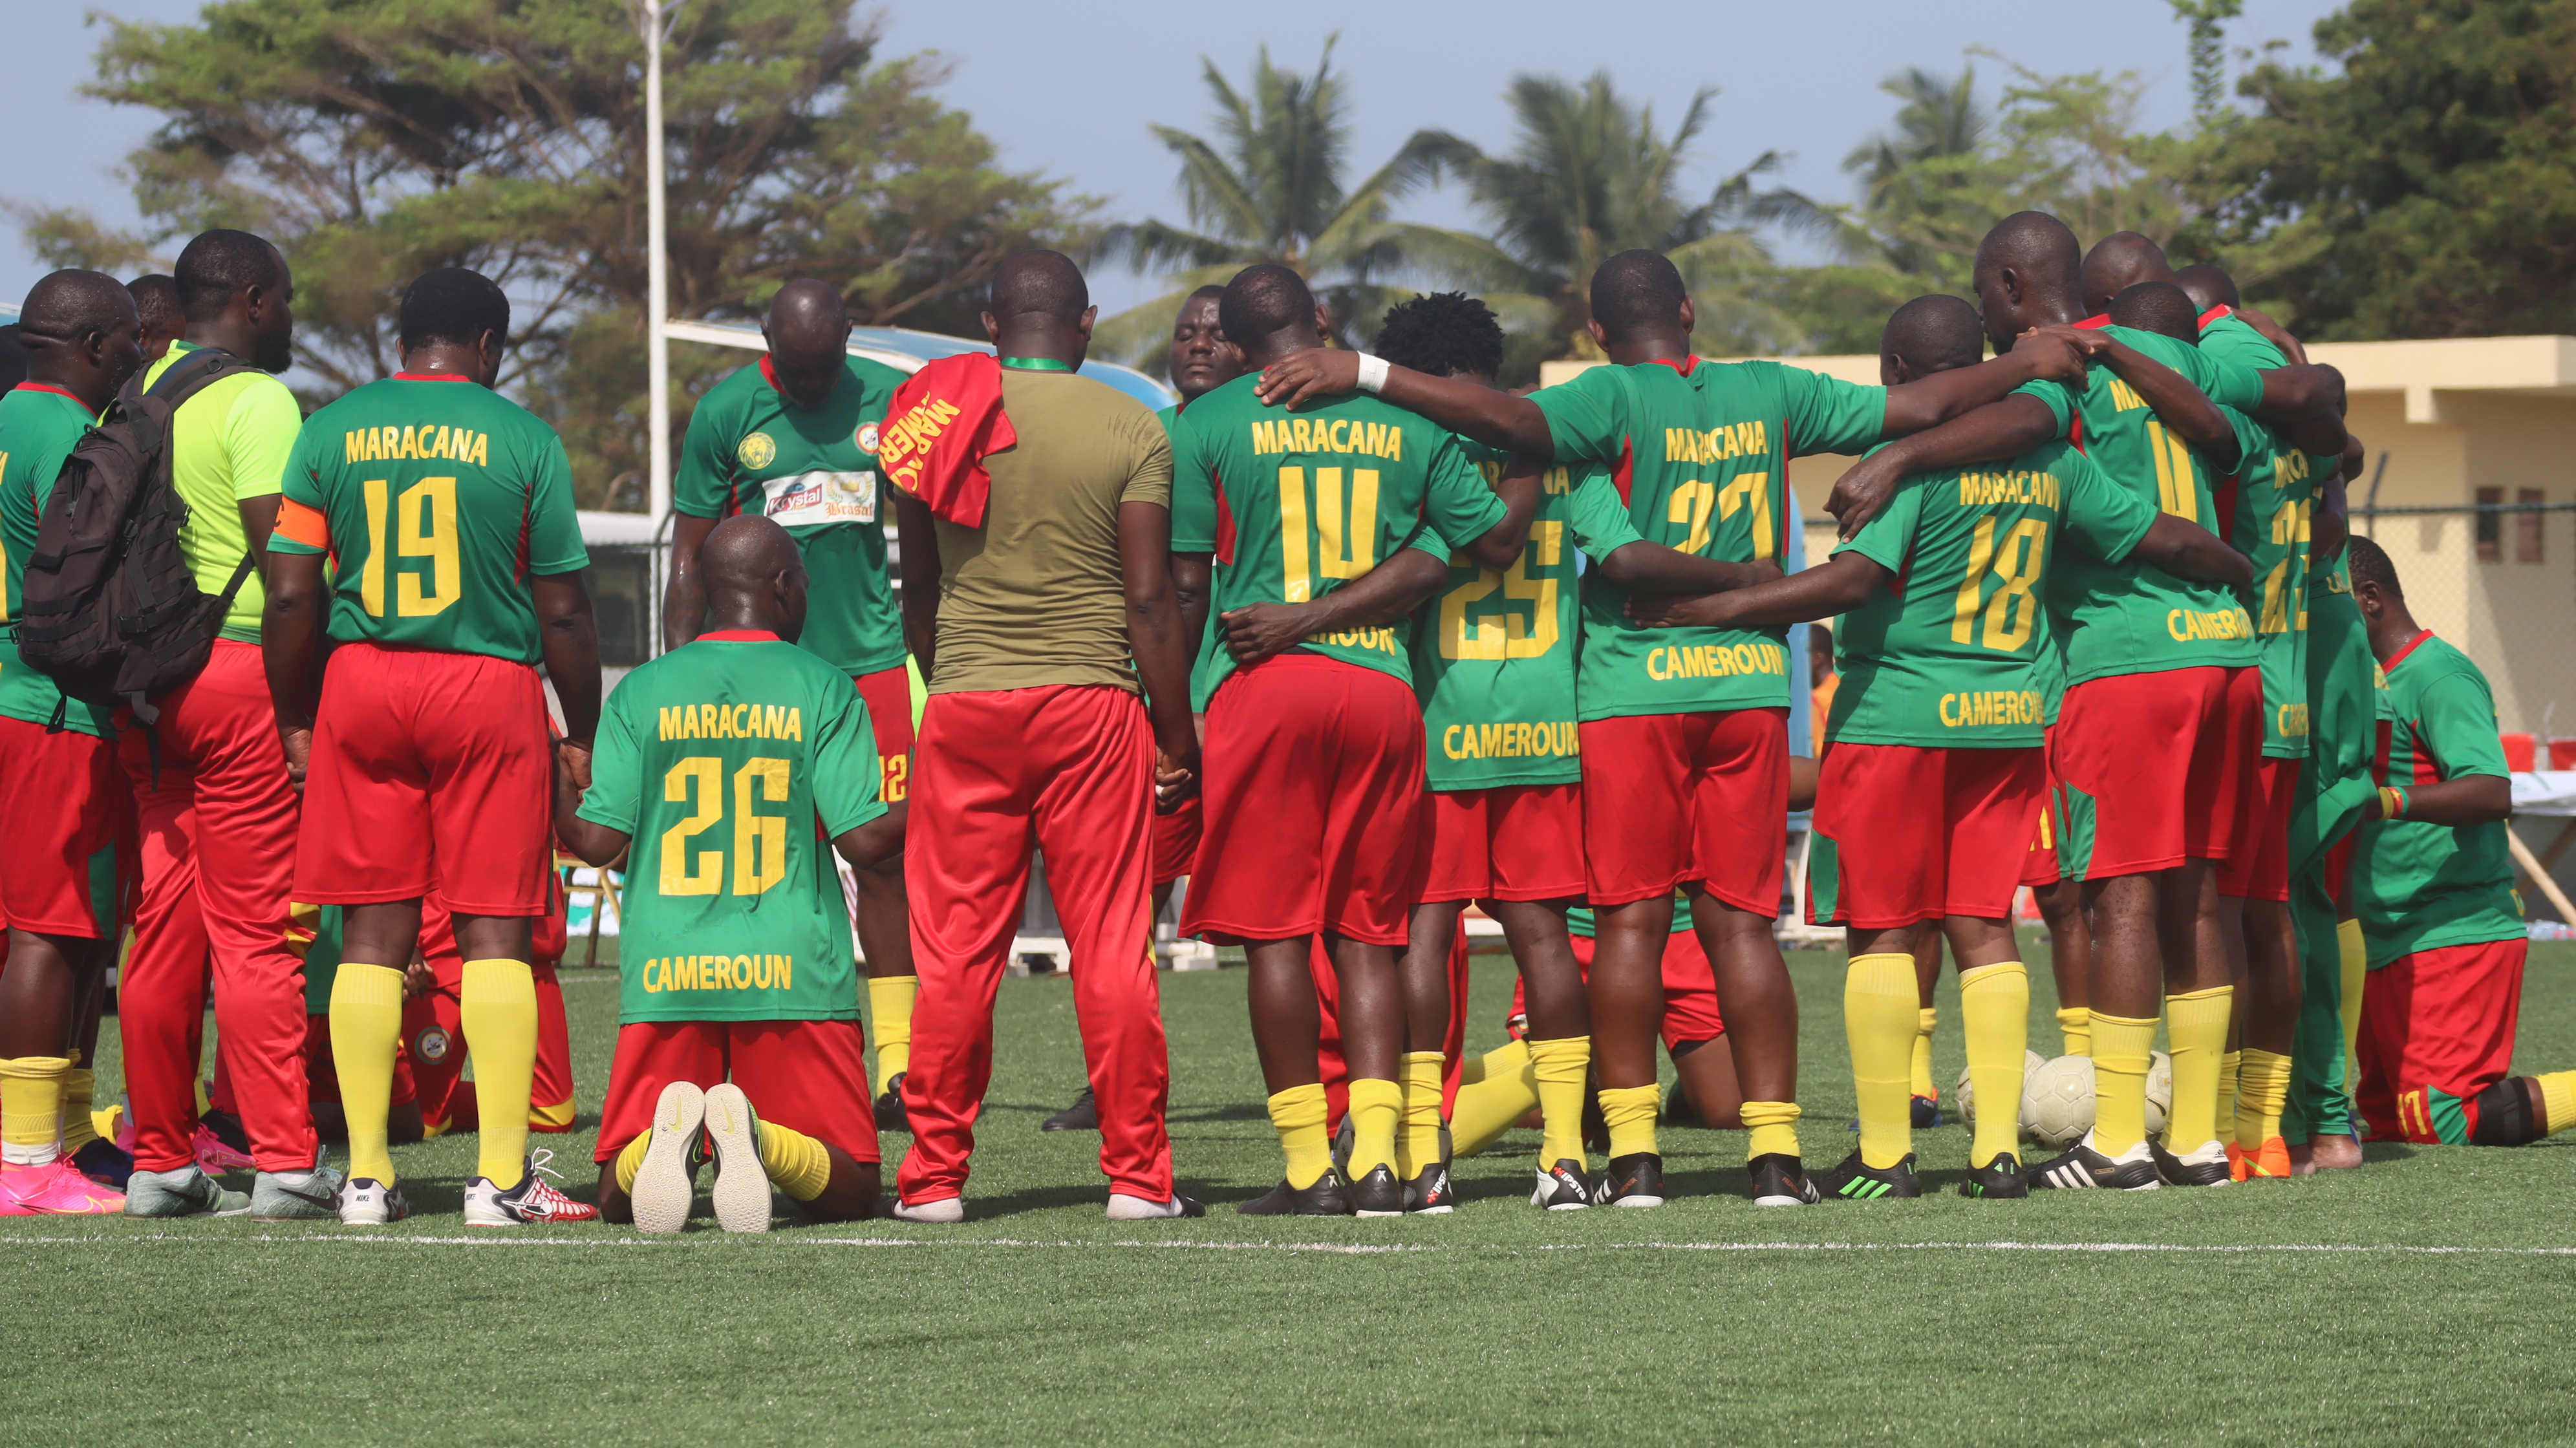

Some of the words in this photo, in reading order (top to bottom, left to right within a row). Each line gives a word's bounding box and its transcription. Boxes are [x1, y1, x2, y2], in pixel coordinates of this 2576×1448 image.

[346, 425, 488, 467] MARACANA
[1252, 418, 1402, 462] MARACANA
[1665, 420, 1769, 466] MARACANA
[769, 487, 821, 515] Krystal
[1668, 471, 1774, 561] 27
[360, 476, 462, 618] 19
[1279, 466, 1380, 603] 14
[1439, 520, 1563, 661] 25
[1951, 515, 2048, 652] 18
[2167, 607, 2254, 641] CAMERO
[1648, 643, 1785, 681] CAMEROUN
[659, 703, 802, 742] MARACANA
[1443, 721, 1580, 760] CAMEROUN
[878, 754, 907, 802] 12
[659, 756, 790, 896] 26
[643, 954, 792, 994] CAMEROUN
[2398, 1090, 2428, 1136] 17
